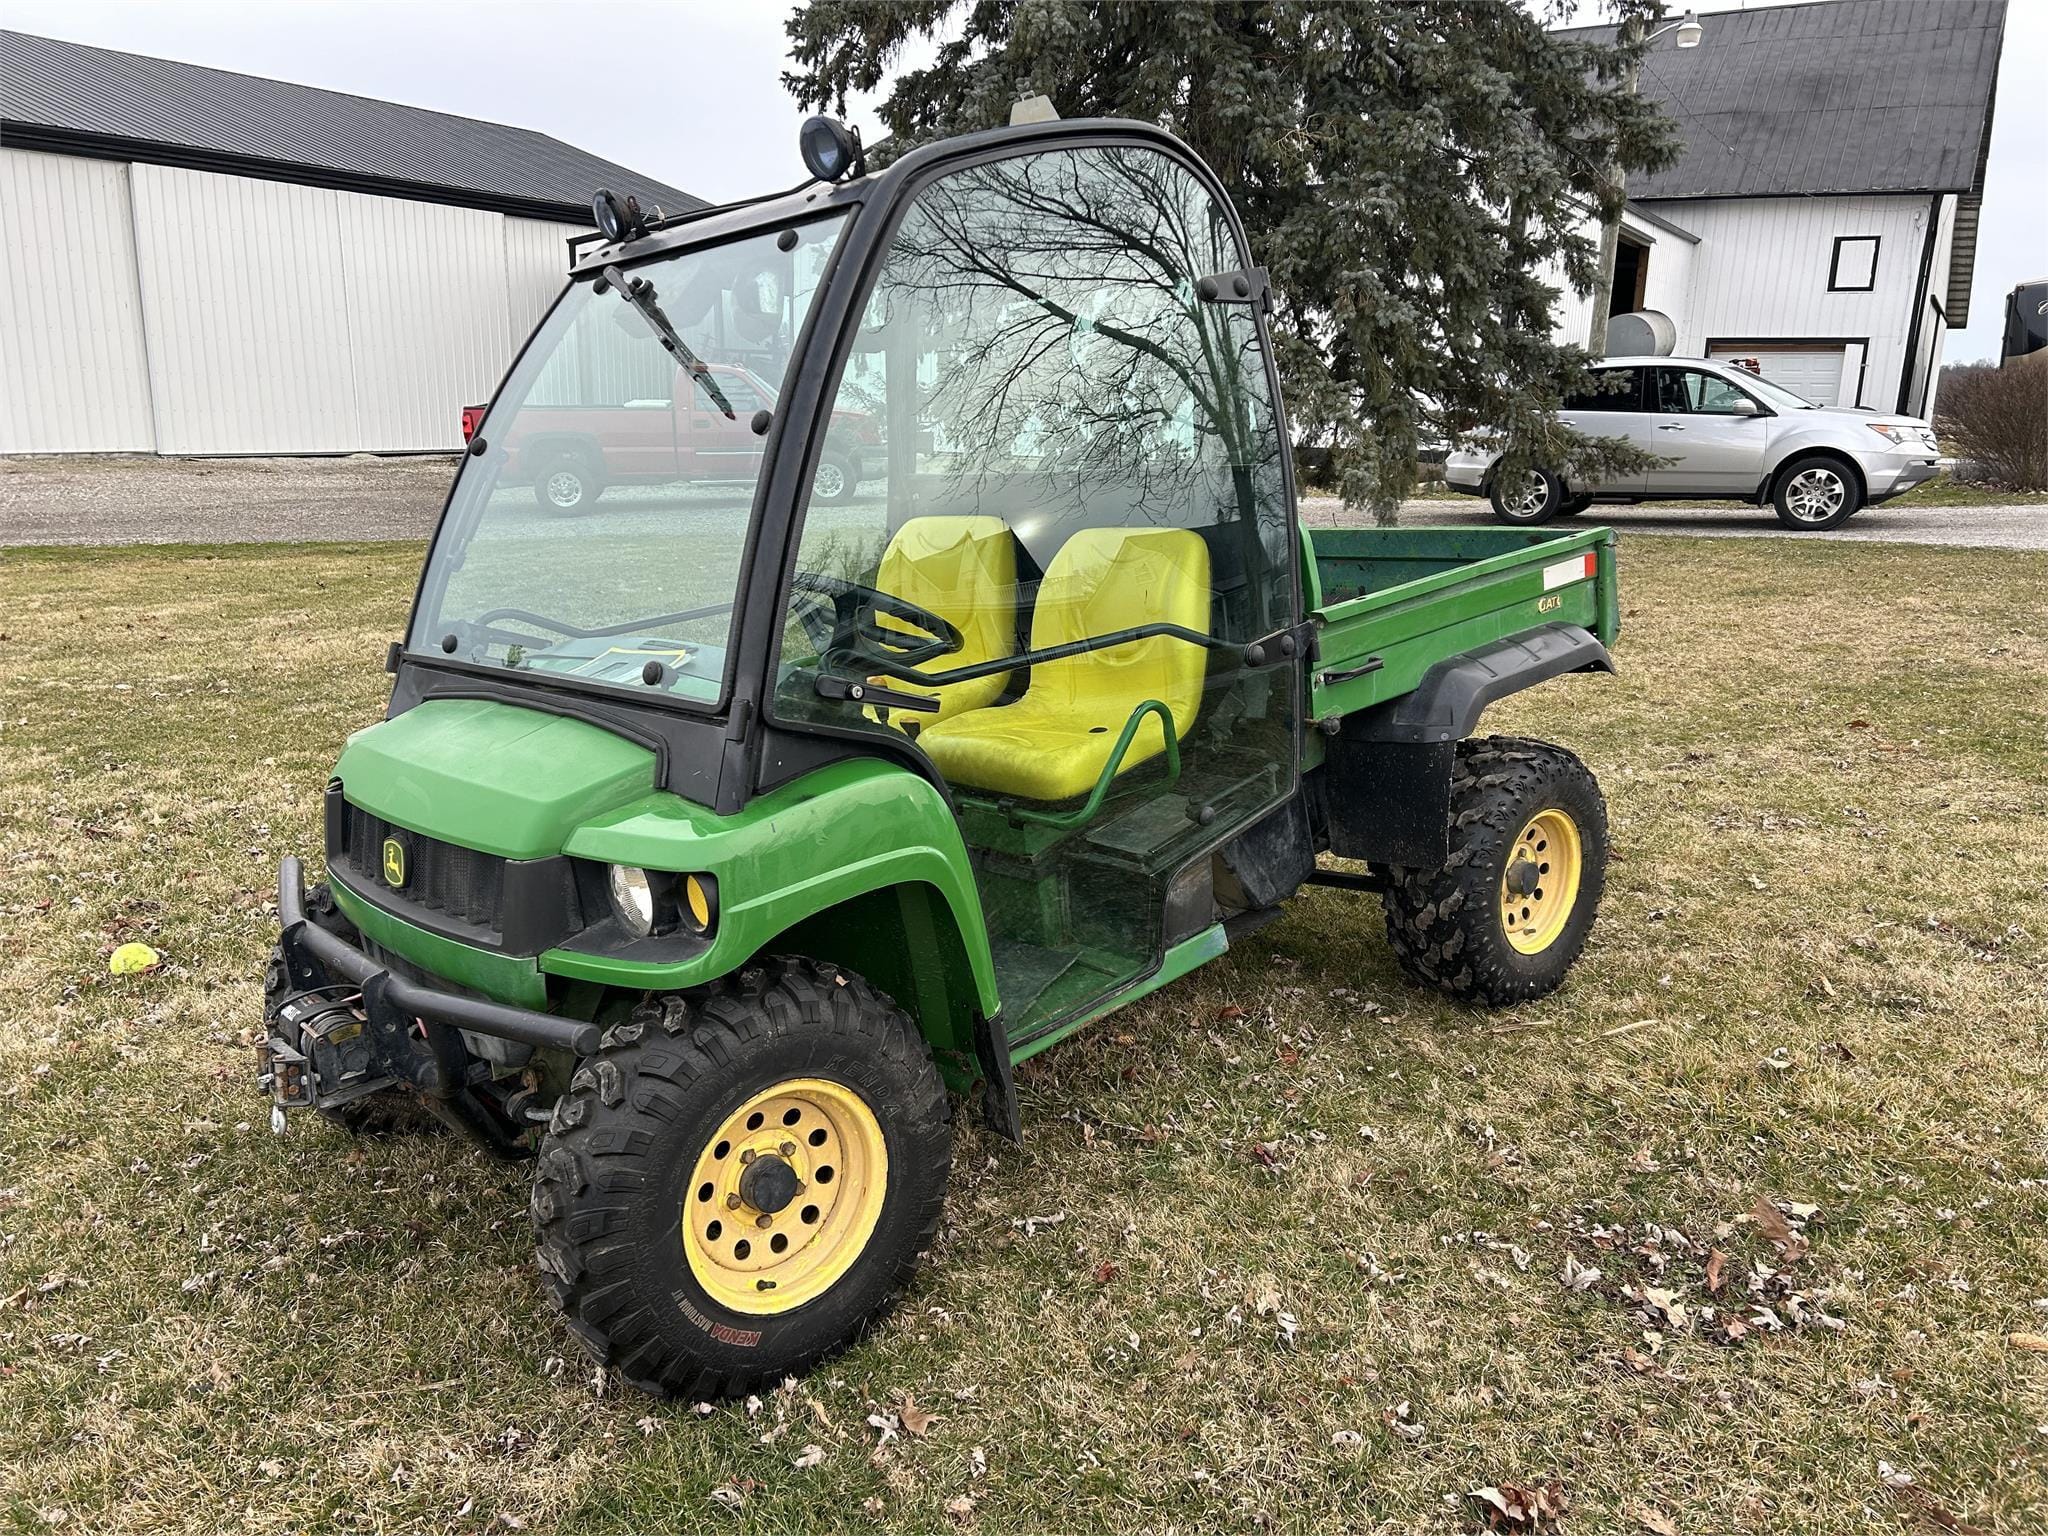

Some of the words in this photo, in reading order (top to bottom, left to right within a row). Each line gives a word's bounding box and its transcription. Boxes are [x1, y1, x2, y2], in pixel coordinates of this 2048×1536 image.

[823, 1054, 901, 1119] KENDA
[678, 1298, 714, 1332] MASTODON
[709, 1322, 762, 1347] KENDA
